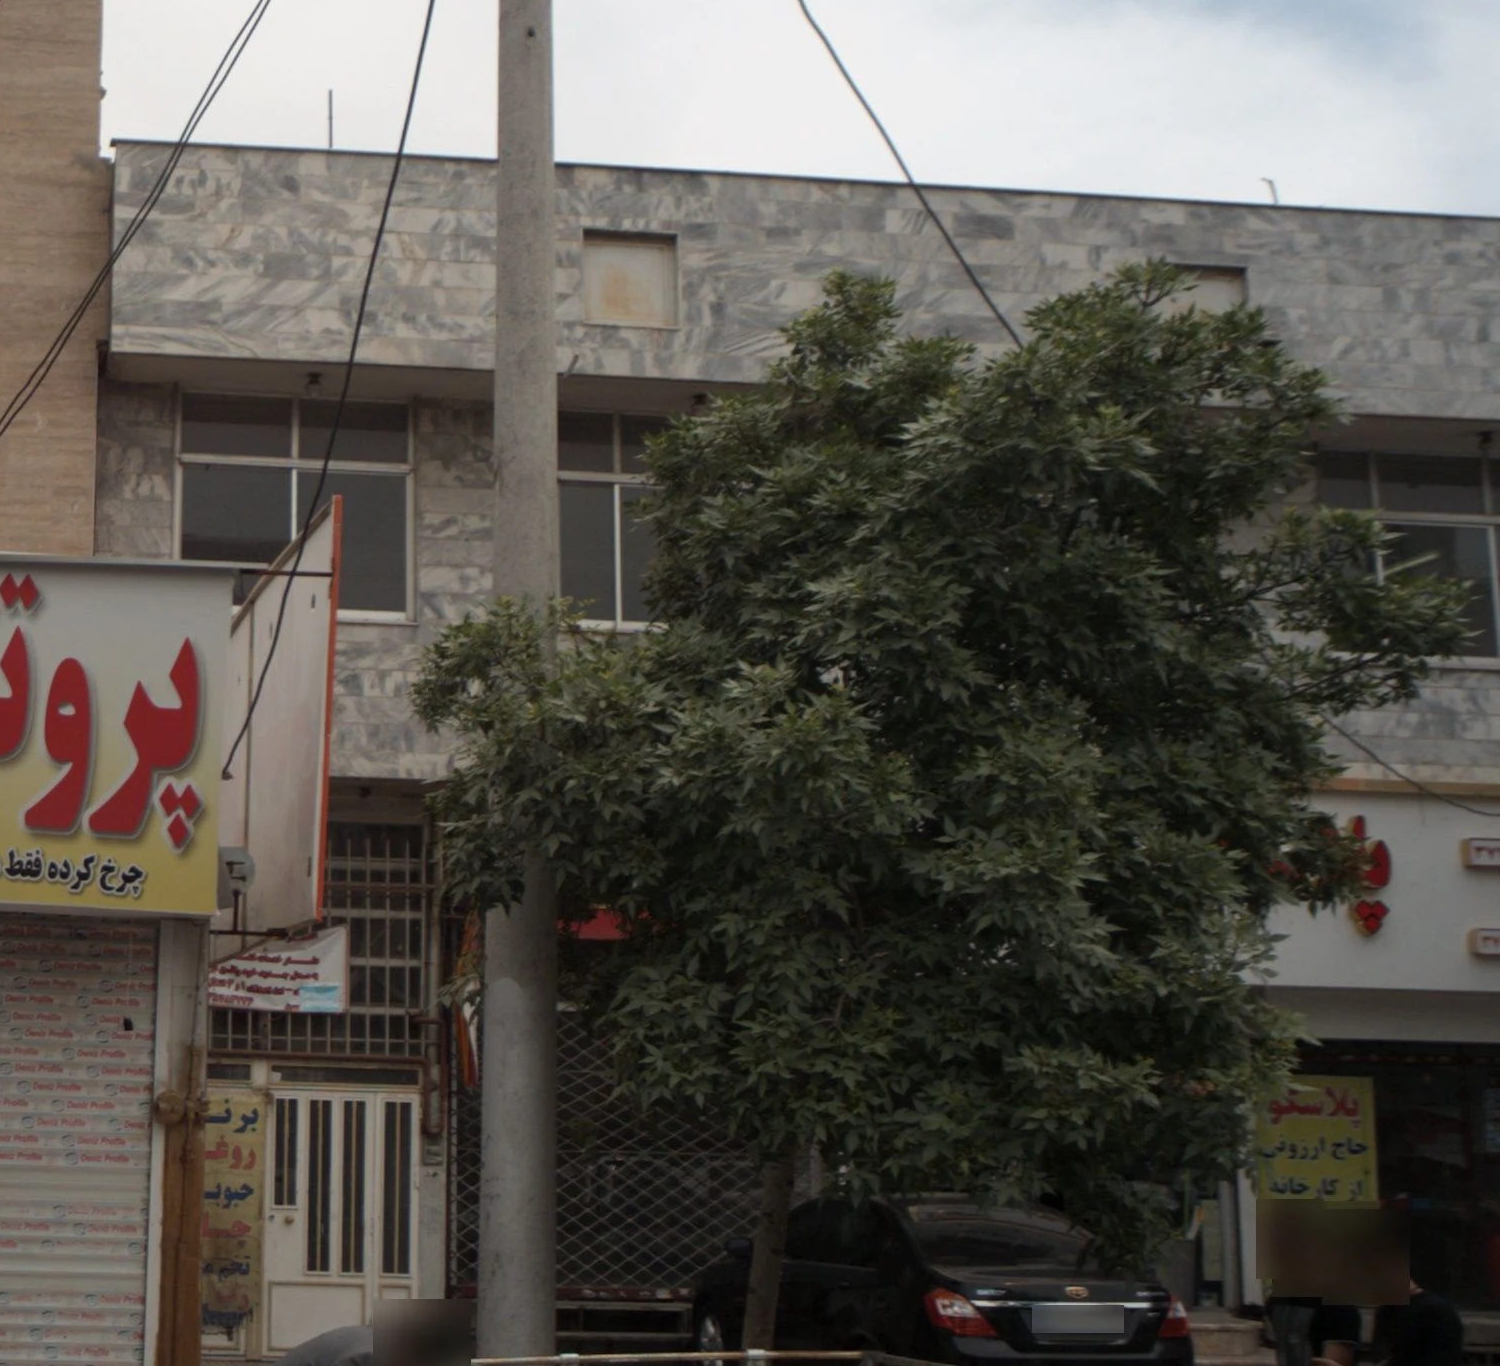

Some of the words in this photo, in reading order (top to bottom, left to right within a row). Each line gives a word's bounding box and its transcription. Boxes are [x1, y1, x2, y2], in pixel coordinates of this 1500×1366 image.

[6, 848, 44, 880] فقط
[47, 853, 97, 891] کرده
[99, 858, 145, 895] چرخ
[203, 1097, 260, 1133] برن
[203, 1133, 257, 1170] روغ
[1331, 1136, 1369, 1161] حاج
[203, 1182, 255, 1209] حبوب
[202, 1210, 252, 1249] چا
